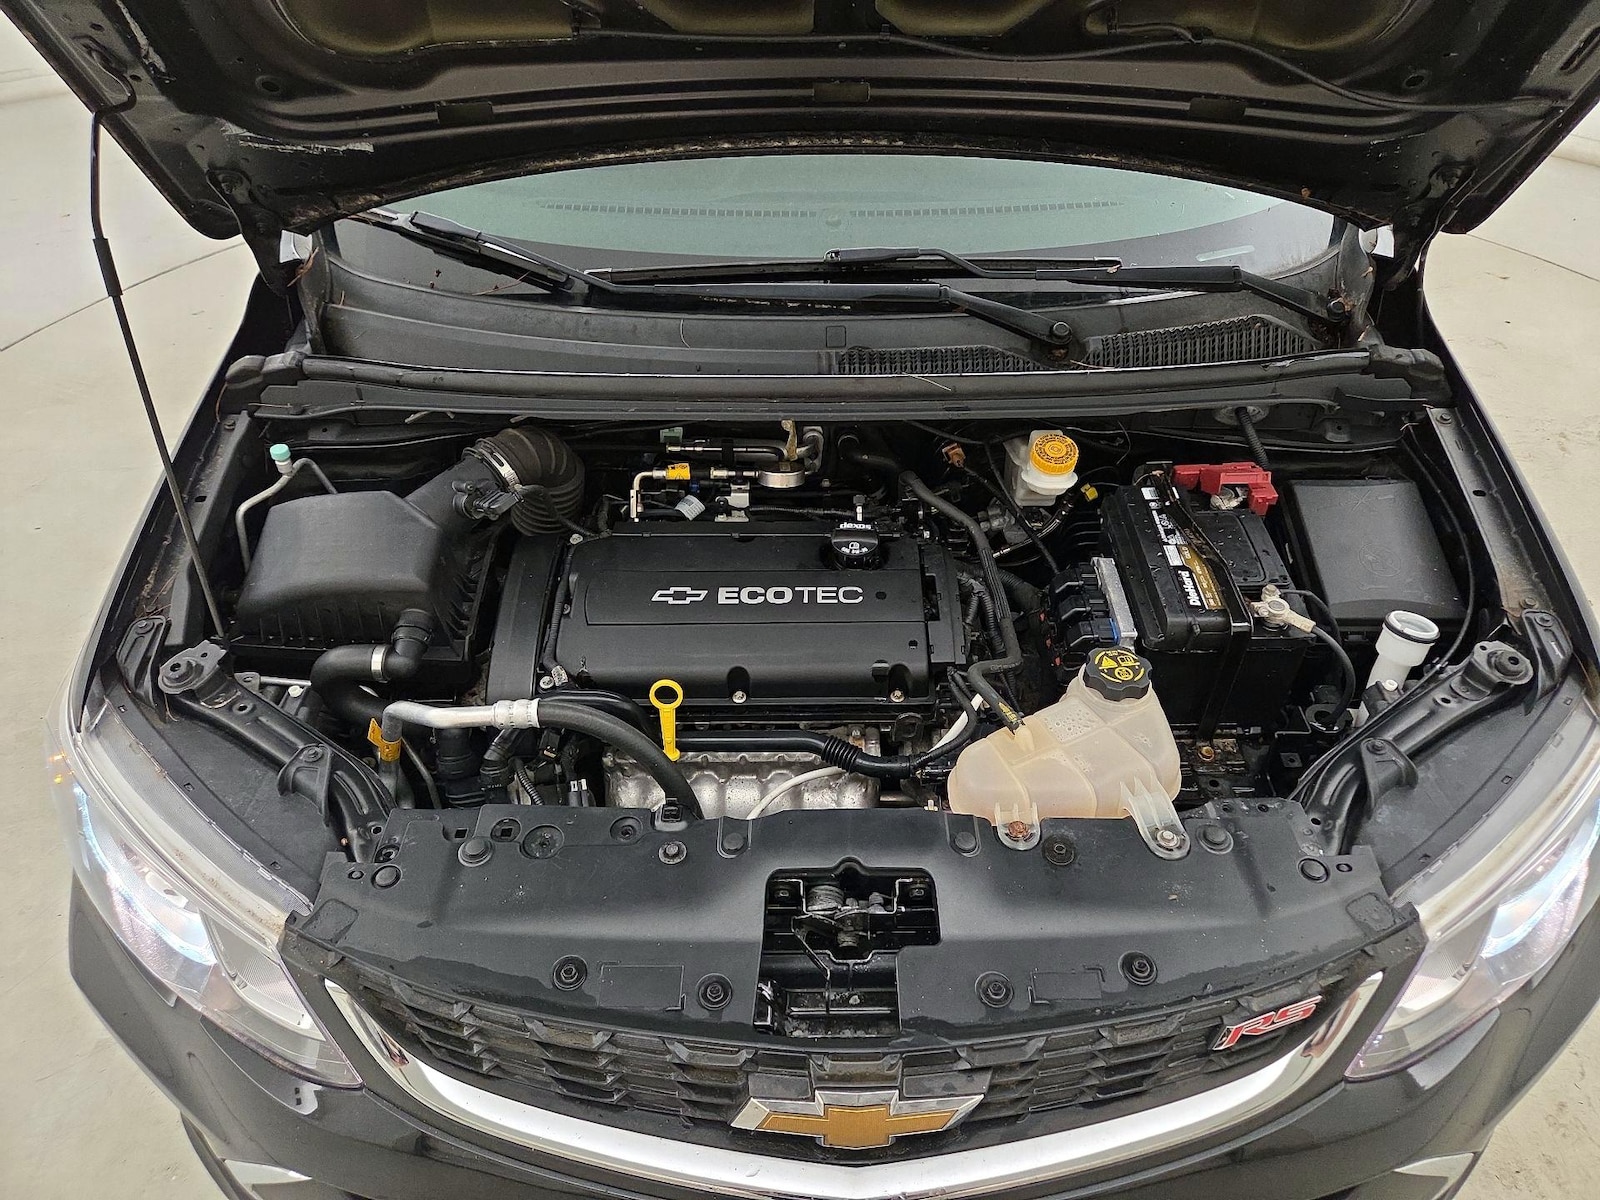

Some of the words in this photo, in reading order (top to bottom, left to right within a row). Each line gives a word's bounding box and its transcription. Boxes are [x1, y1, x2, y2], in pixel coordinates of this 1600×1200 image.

[839, 522, 871, 530] dexos
[717, 586, 864, 605] ECOTEC
[1178, 570, 1201, 606] DieHard
[1212, 995, 1323, 1050] RS
